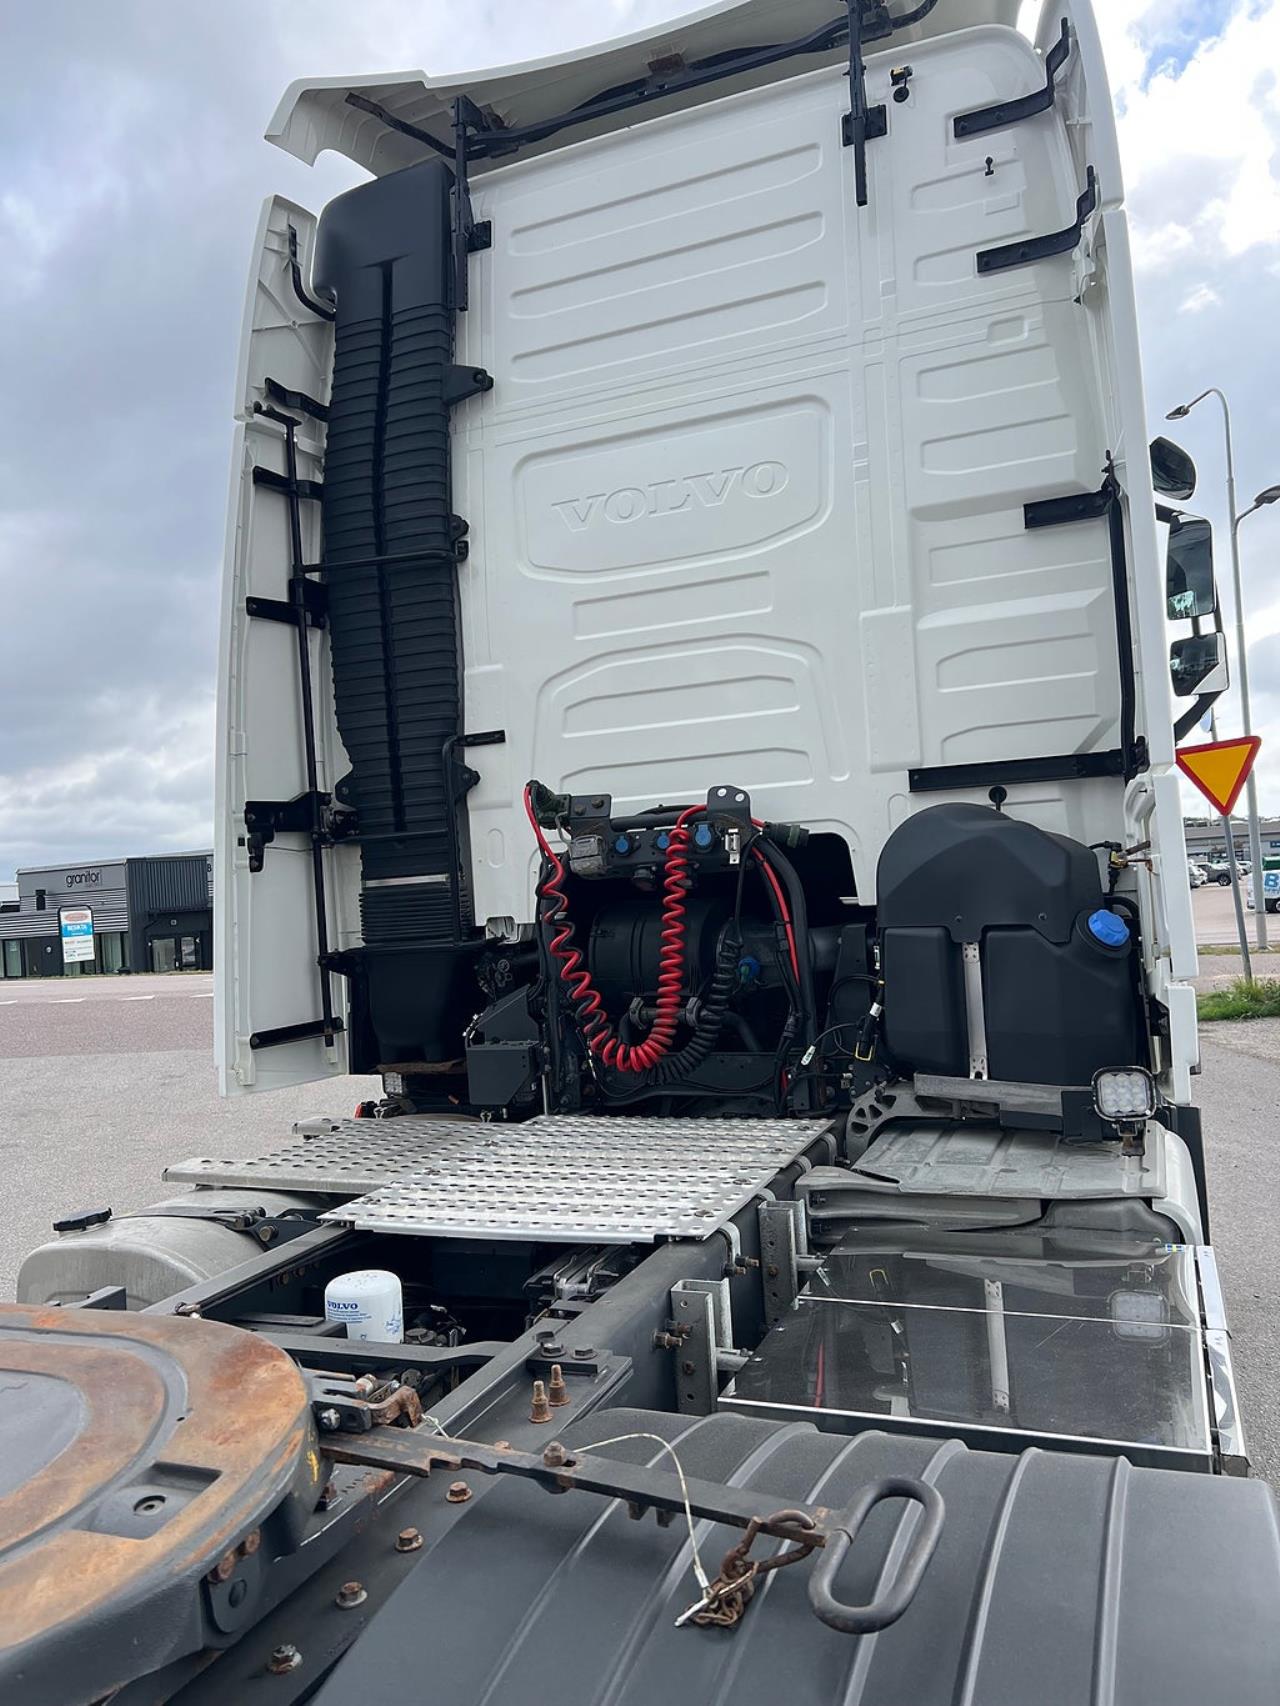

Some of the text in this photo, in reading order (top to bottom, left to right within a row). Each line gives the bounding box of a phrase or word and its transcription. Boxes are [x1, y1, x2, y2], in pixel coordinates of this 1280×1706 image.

[551, 460, 790, 532] VOLVO
[66, 870, 100, 888] granitor
[327, 1300, 358, 1310] VOLVO
